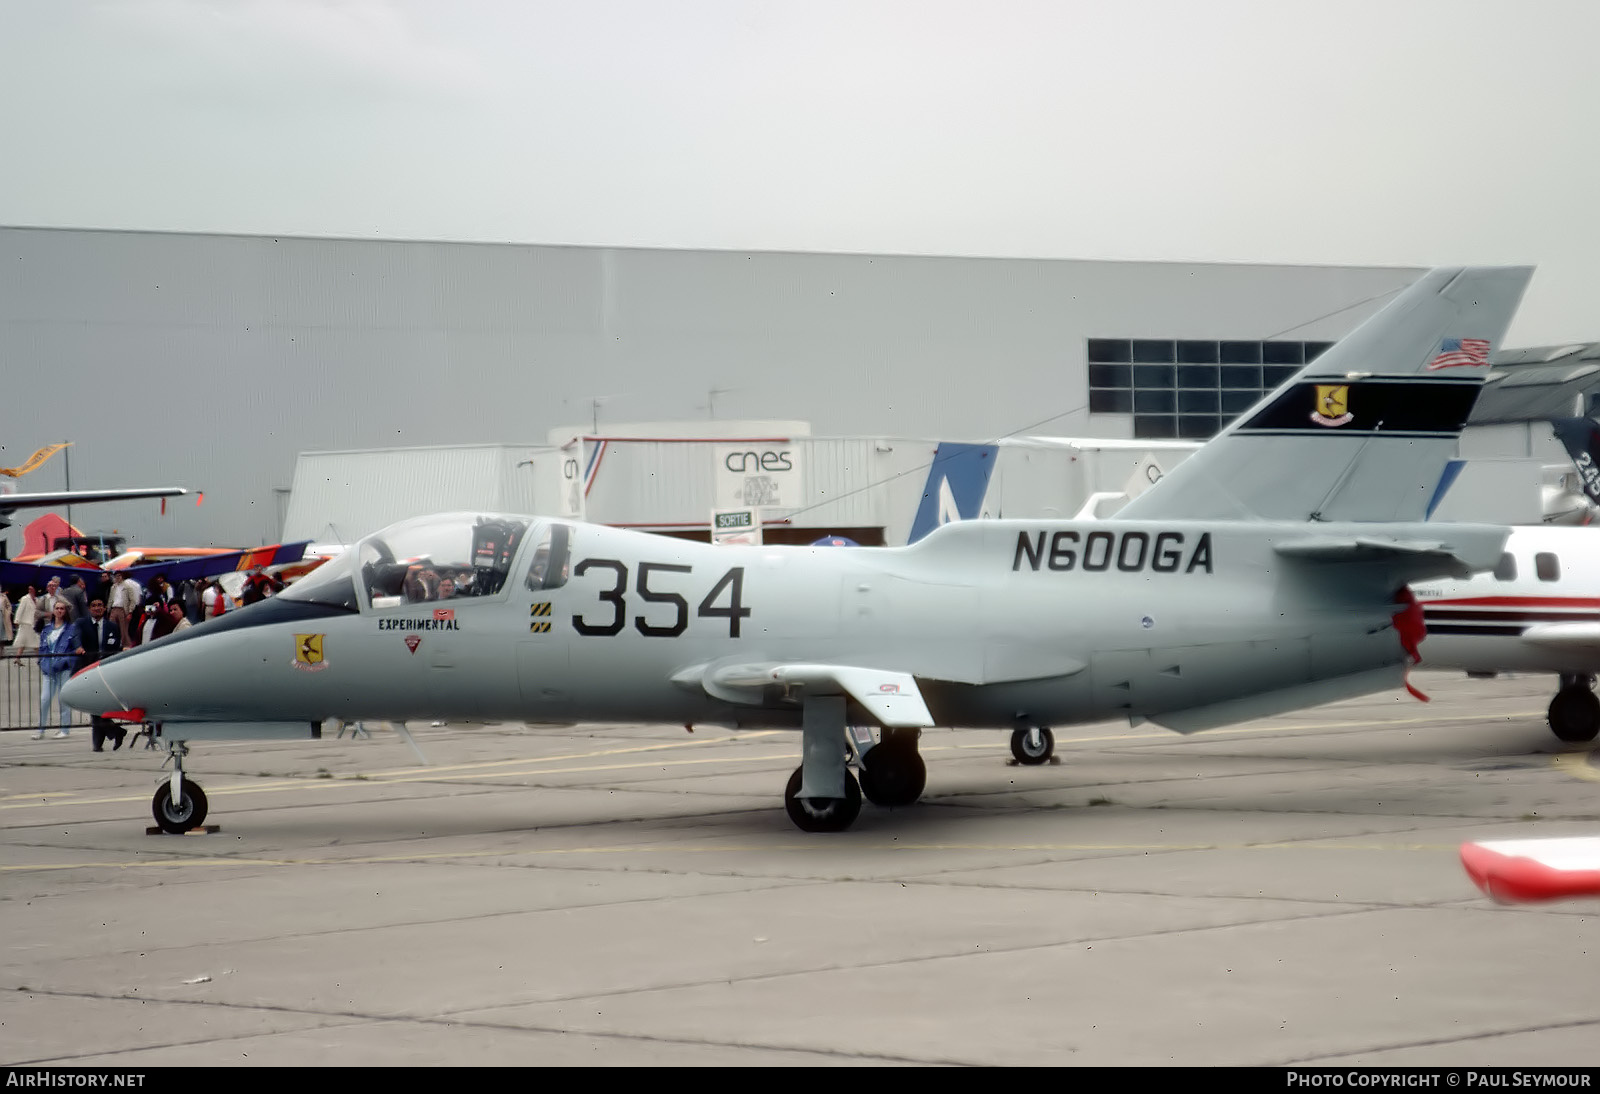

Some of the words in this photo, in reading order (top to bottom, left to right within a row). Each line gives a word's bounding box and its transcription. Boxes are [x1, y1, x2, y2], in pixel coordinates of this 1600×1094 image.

[726, 451, 792, 472] cnes
[719, 513, 749, 527] SORTIE
[1012, 531, 1214, 574] N600GA
[572, 557, 751, 638] 354
[379, 619, 460, 631] EXPERIMENTAL
